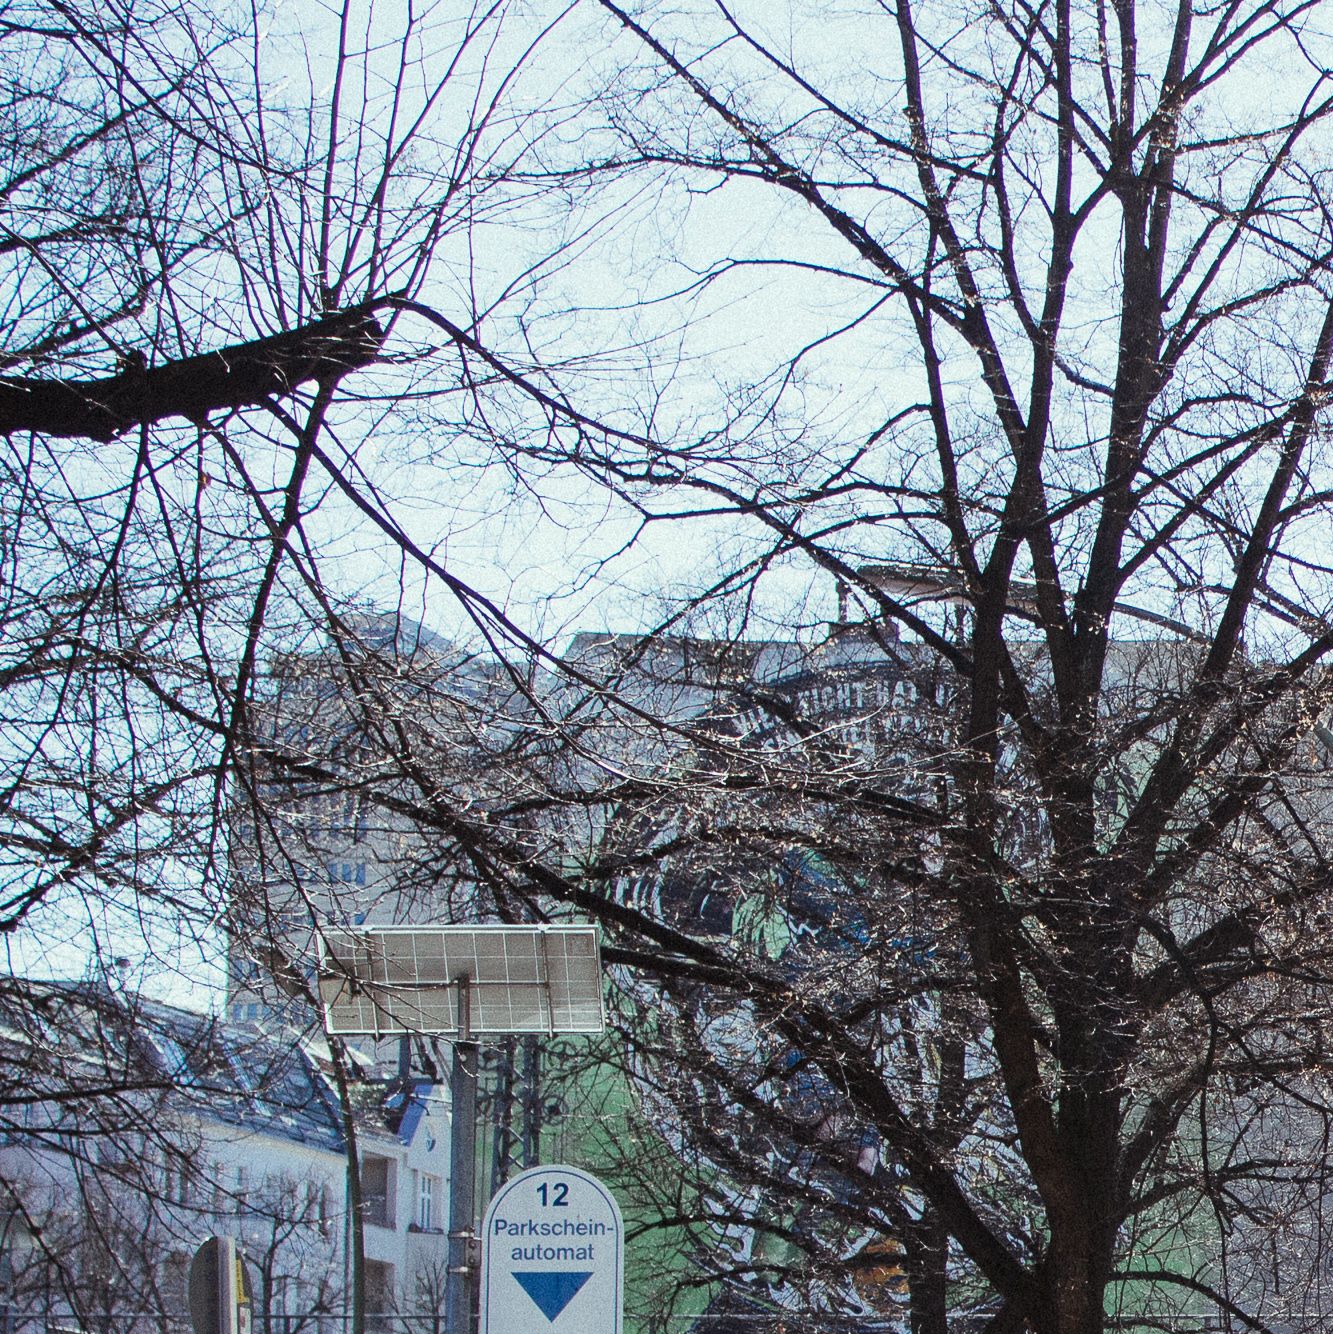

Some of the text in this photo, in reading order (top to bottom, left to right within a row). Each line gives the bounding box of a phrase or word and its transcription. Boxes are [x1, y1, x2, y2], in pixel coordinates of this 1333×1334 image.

[536, 1182, 569, 1207] 12
[494, 1219, 614, 1236] Parkschein-
[511, 1246, 594, 1260] automat
